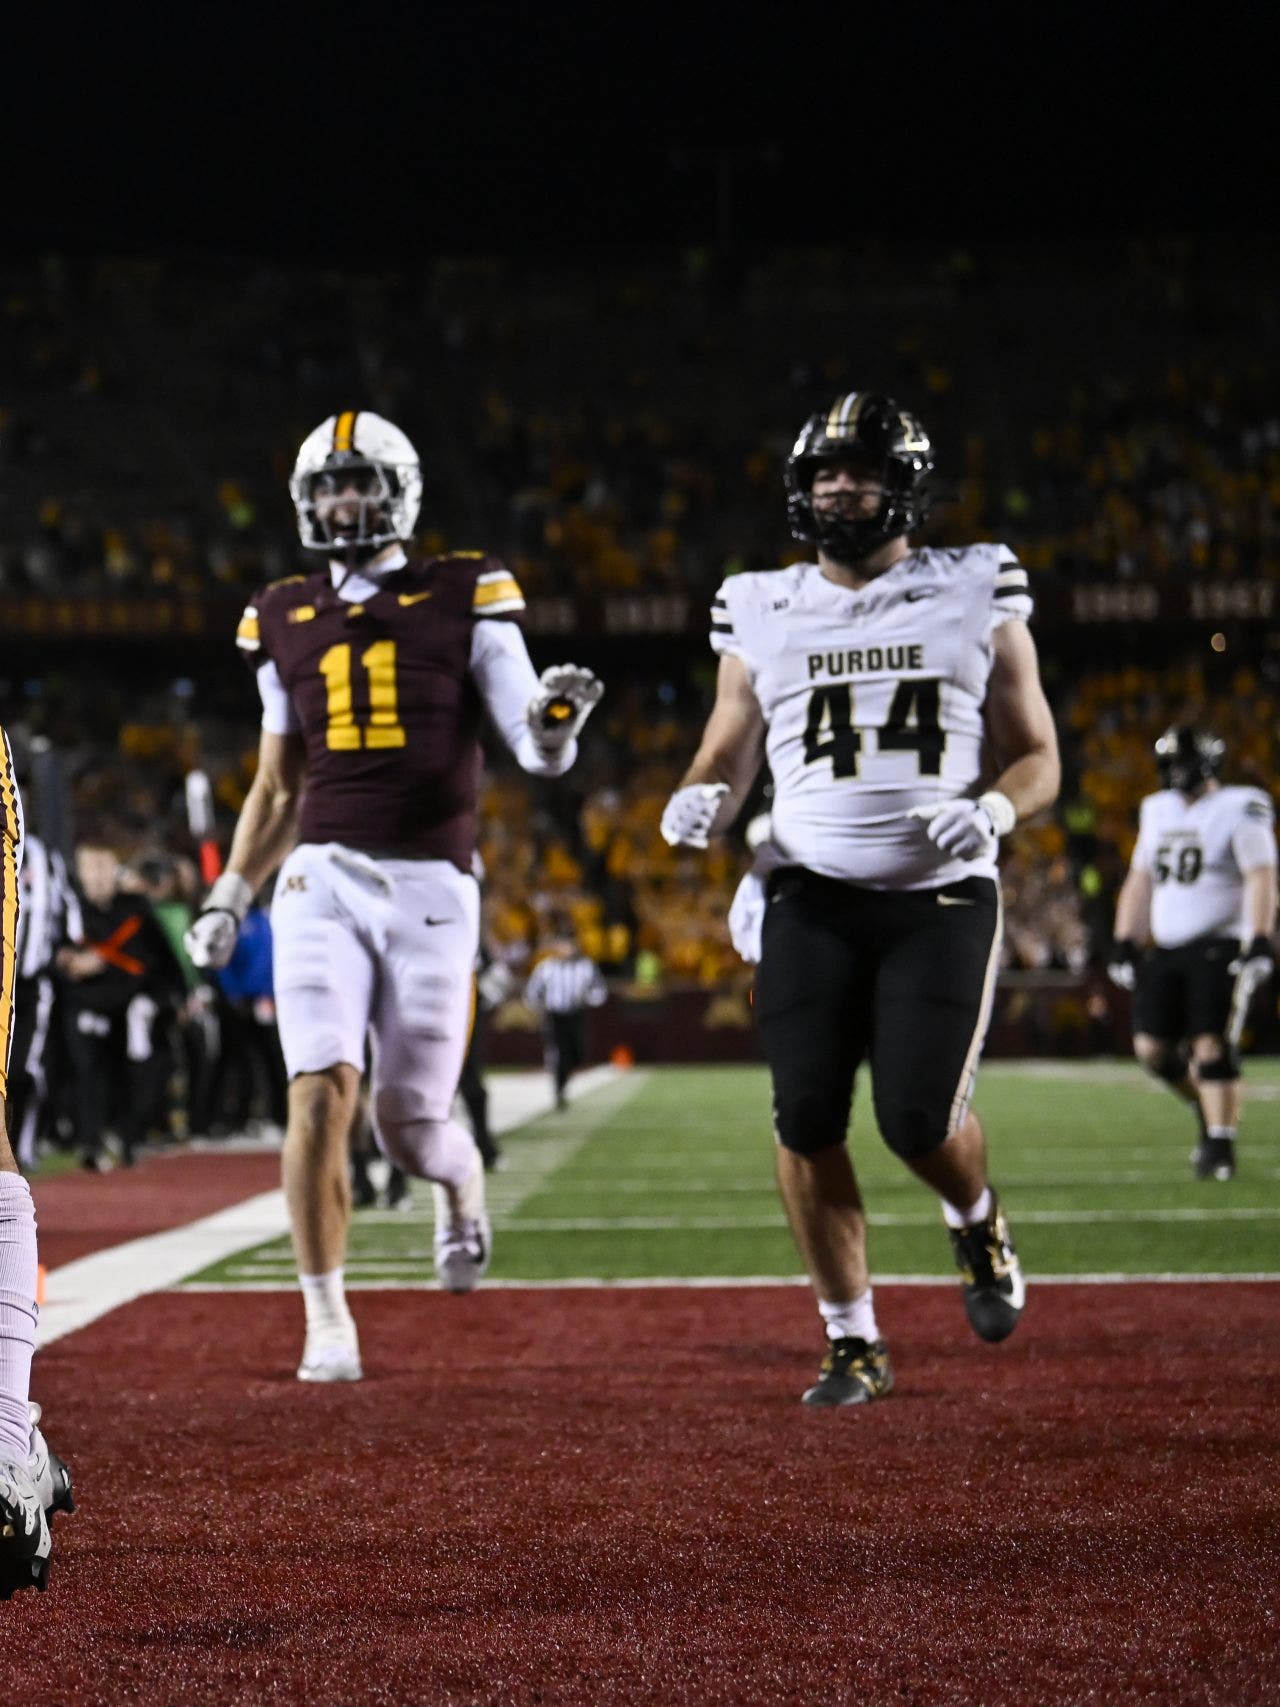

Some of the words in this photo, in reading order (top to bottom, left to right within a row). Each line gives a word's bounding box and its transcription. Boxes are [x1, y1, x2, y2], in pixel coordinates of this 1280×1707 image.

[319, 640, 406, 751] 11
[808, 645, 924, 680] PURDUE
[803, 678, 947, 780] 44
